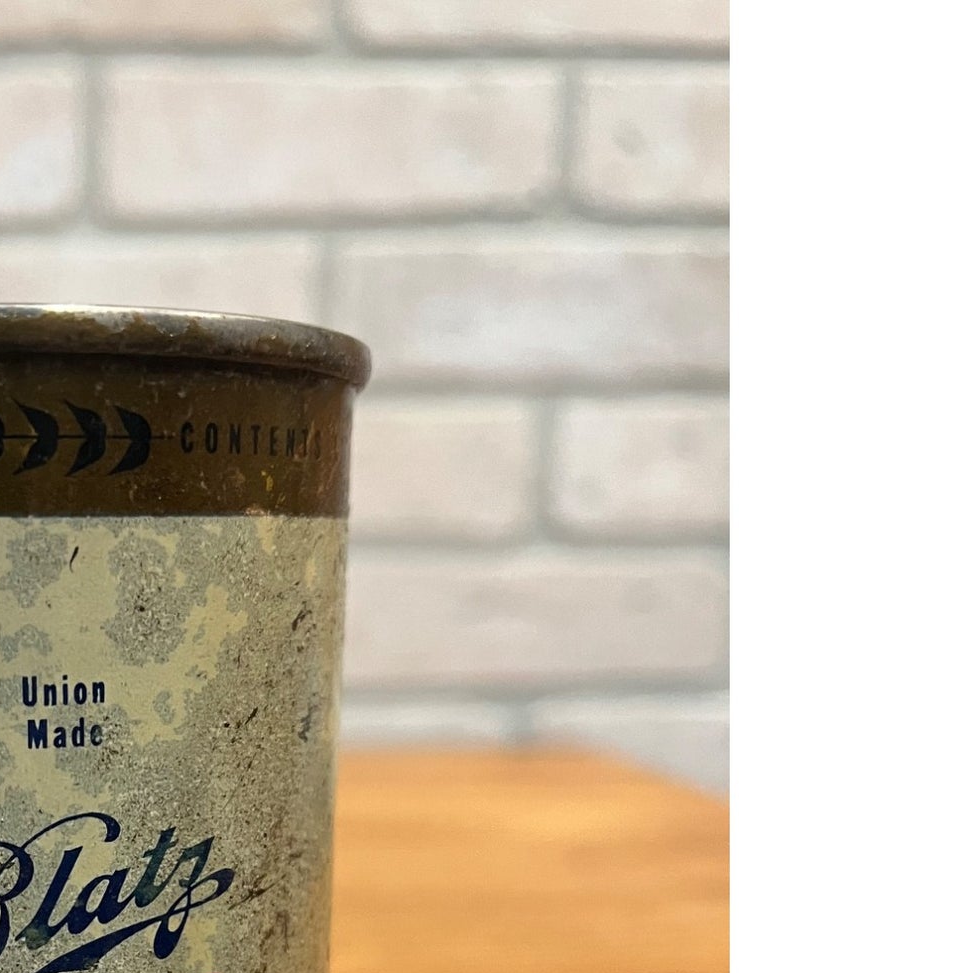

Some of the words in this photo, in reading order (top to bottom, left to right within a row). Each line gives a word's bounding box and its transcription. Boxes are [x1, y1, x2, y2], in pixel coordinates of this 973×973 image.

[180, 421, 321, 460] CONTENTS
[22, 674, 105, 707] Union
[27, 717, 103, 749] Made
